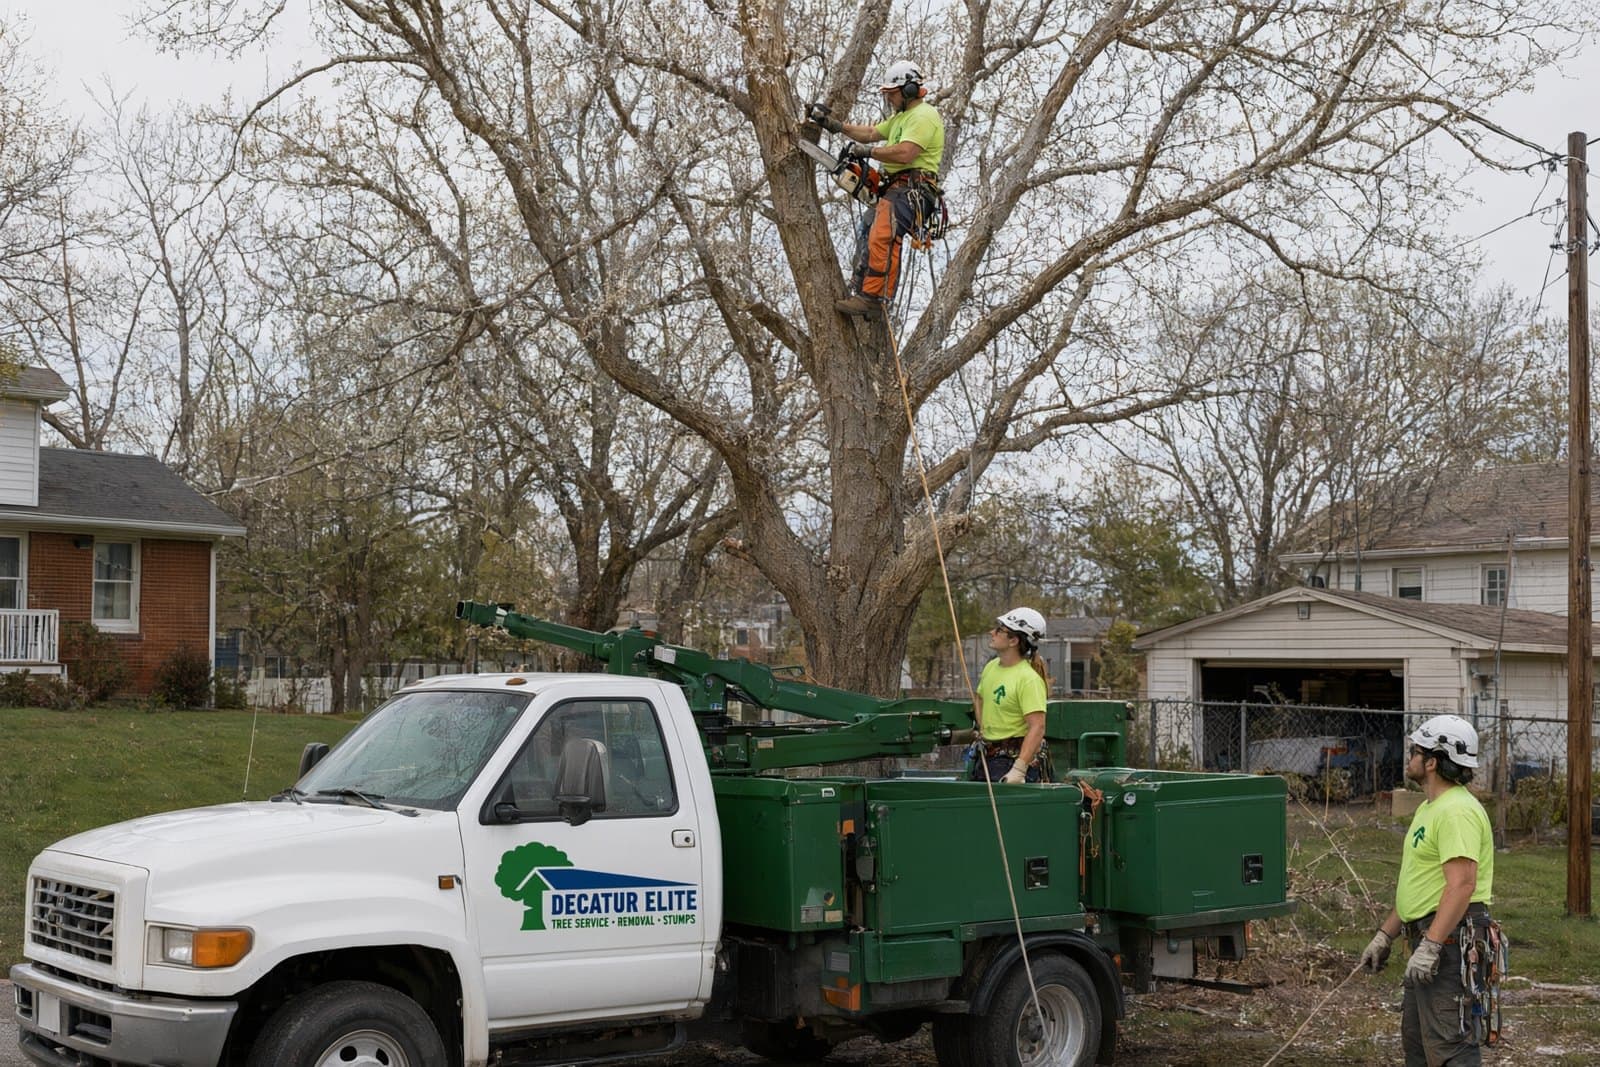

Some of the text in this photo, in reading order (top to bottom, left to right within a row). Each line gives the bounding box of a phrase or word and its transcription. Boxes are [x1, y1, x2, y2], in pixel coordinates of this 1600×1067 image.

[552, 890, 697, 915] DECATUR ELITE
[552, 914, 695, 929] TREE SERVICE REMOVAL STUMPS
